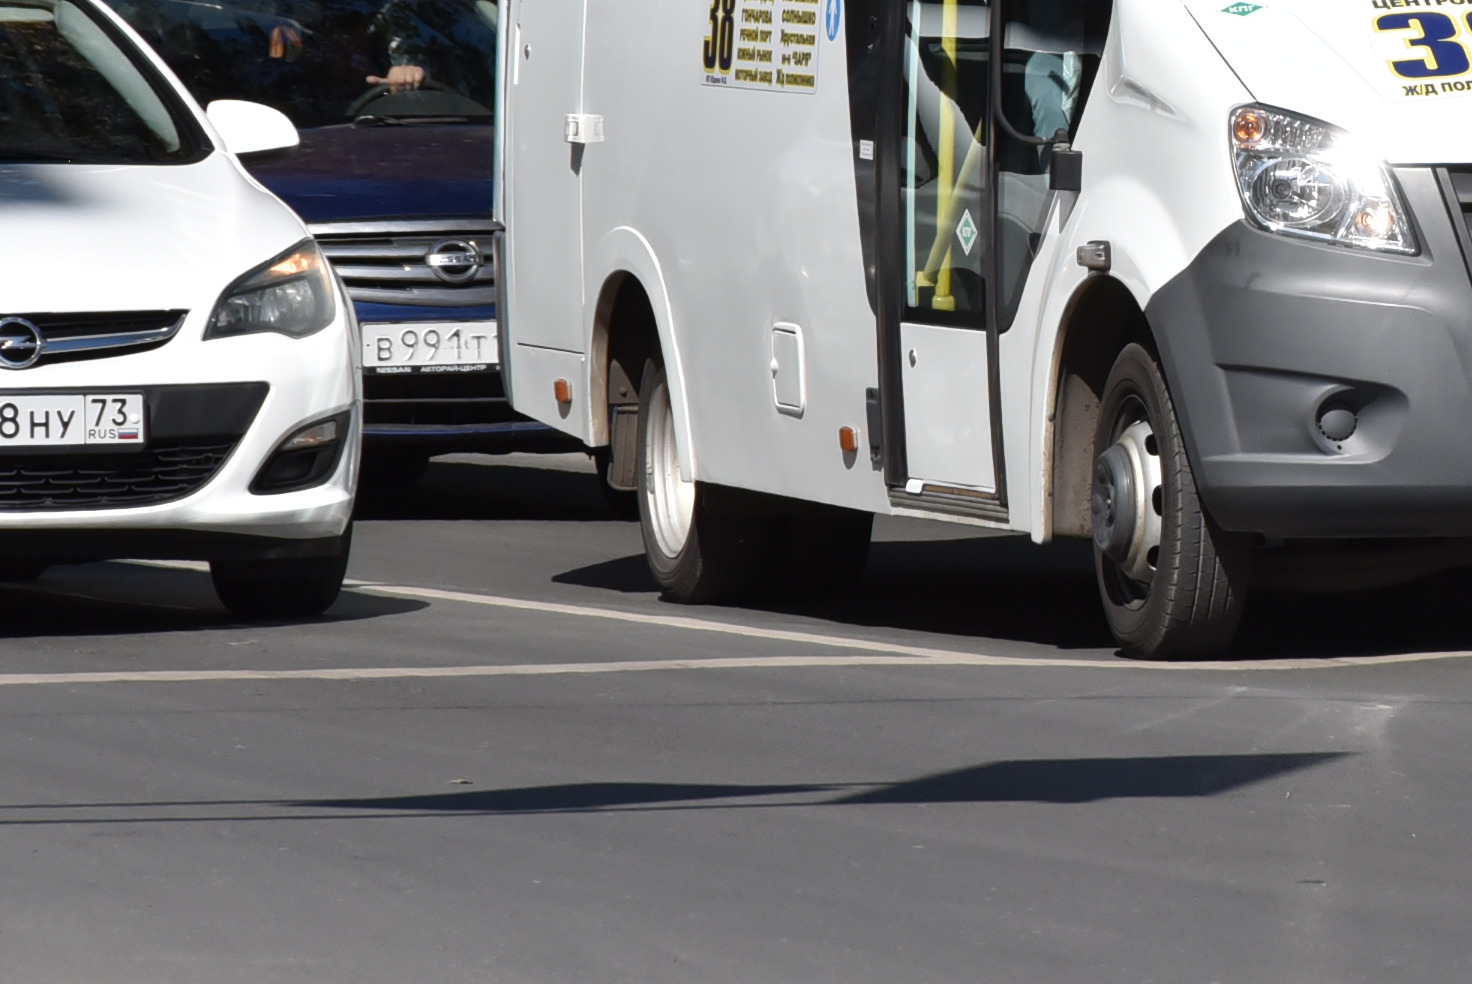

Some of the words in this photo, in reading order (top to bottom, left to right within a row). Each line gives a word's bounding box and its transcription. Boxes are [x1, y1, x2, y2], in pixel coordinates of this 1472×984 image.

[1229, 5, 1254, 13] КПГ
[1402, 83, 1438, 96] Ж/Д
[376, 327, 498, 362] В991Т
[90, 398, 128, 427] 73
[88, 428, 117, 440] RUS
